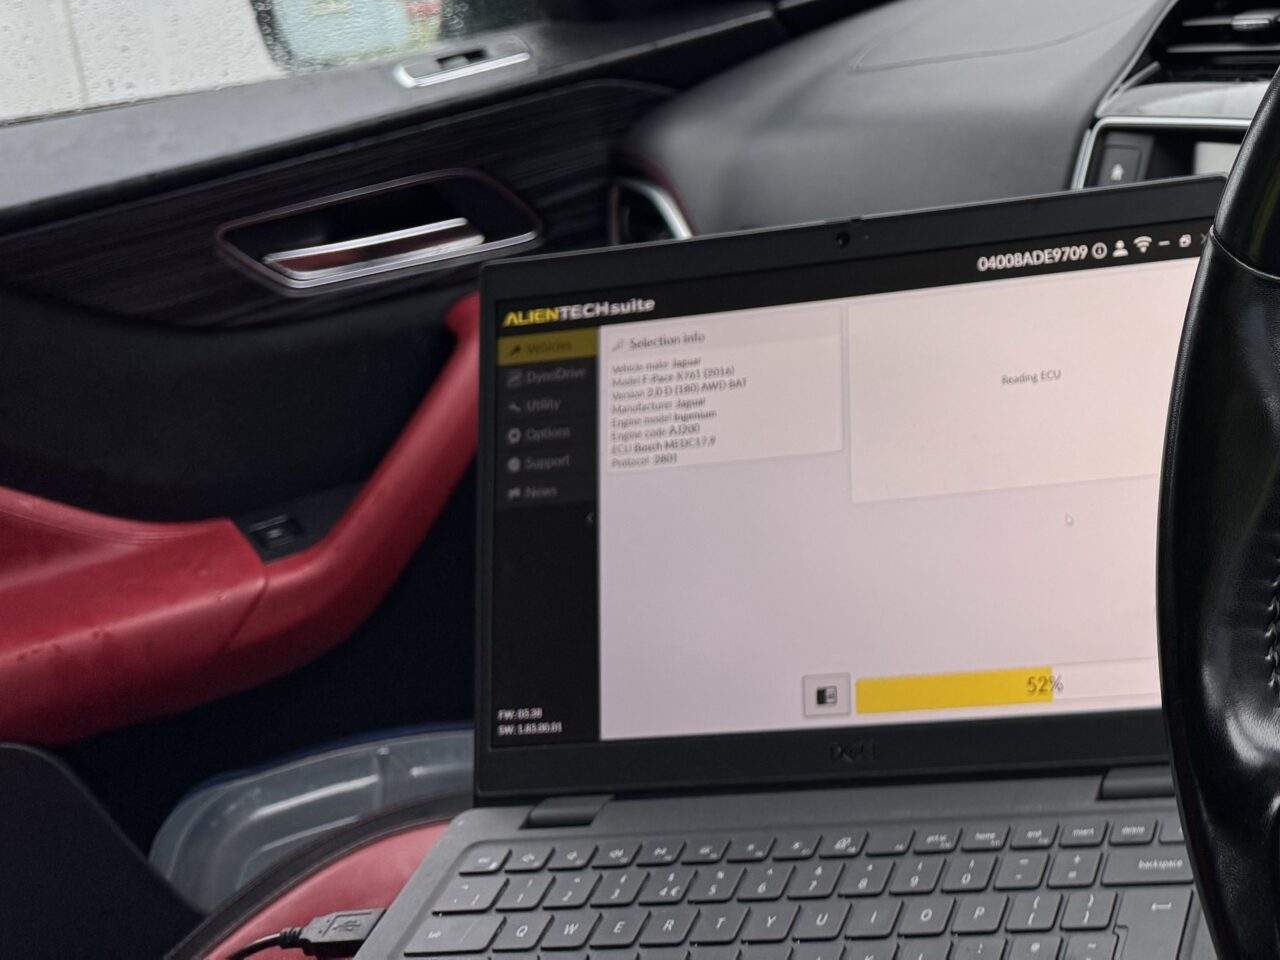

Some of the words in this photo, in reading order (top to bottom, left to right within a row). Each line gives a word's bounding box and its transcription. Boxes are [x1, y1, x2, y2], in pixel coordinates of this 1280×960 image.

[1001, 371, 1039, 386] Reading
[1041, 369, 1062, 381] ECU
[1026, 674, 1064, 695] 52%
[1137, 858, 1184, 871] backspace
[815, 913, 829, 926] U
[973, 906, 985, 920] P
[613, 921, 625, 933] E
[766, 915, 776, 928] Y
[516, 925, 528, 937] Q
[563, 923, 579, 935] W
